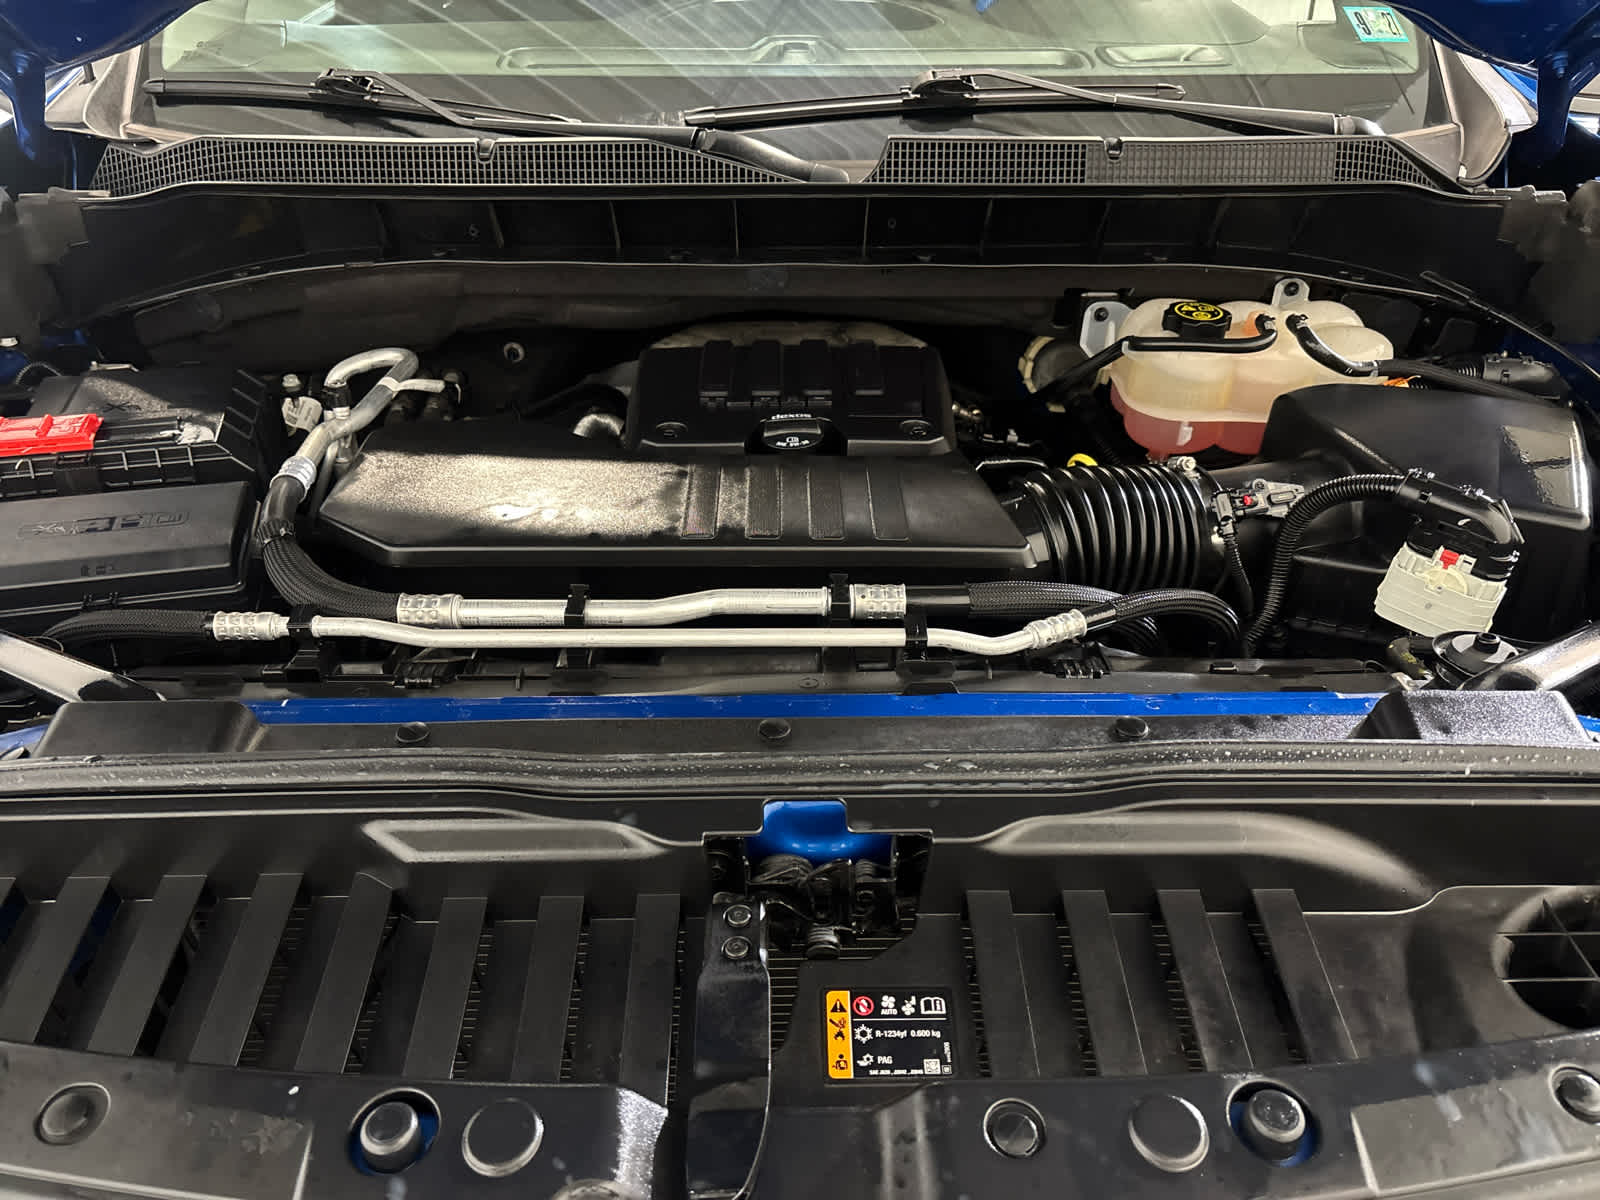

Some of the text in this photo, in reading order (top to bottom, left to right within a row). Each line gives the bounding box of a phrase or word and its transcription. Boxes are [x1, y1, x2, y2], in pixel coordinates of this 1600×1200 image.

[1354, 11, 1372, 35] 9
[875, 1030, 908, 1038] R-1234yf
[932, 1030, 941, 1038] kg
[878, 1056, 893, 1064] PAG
